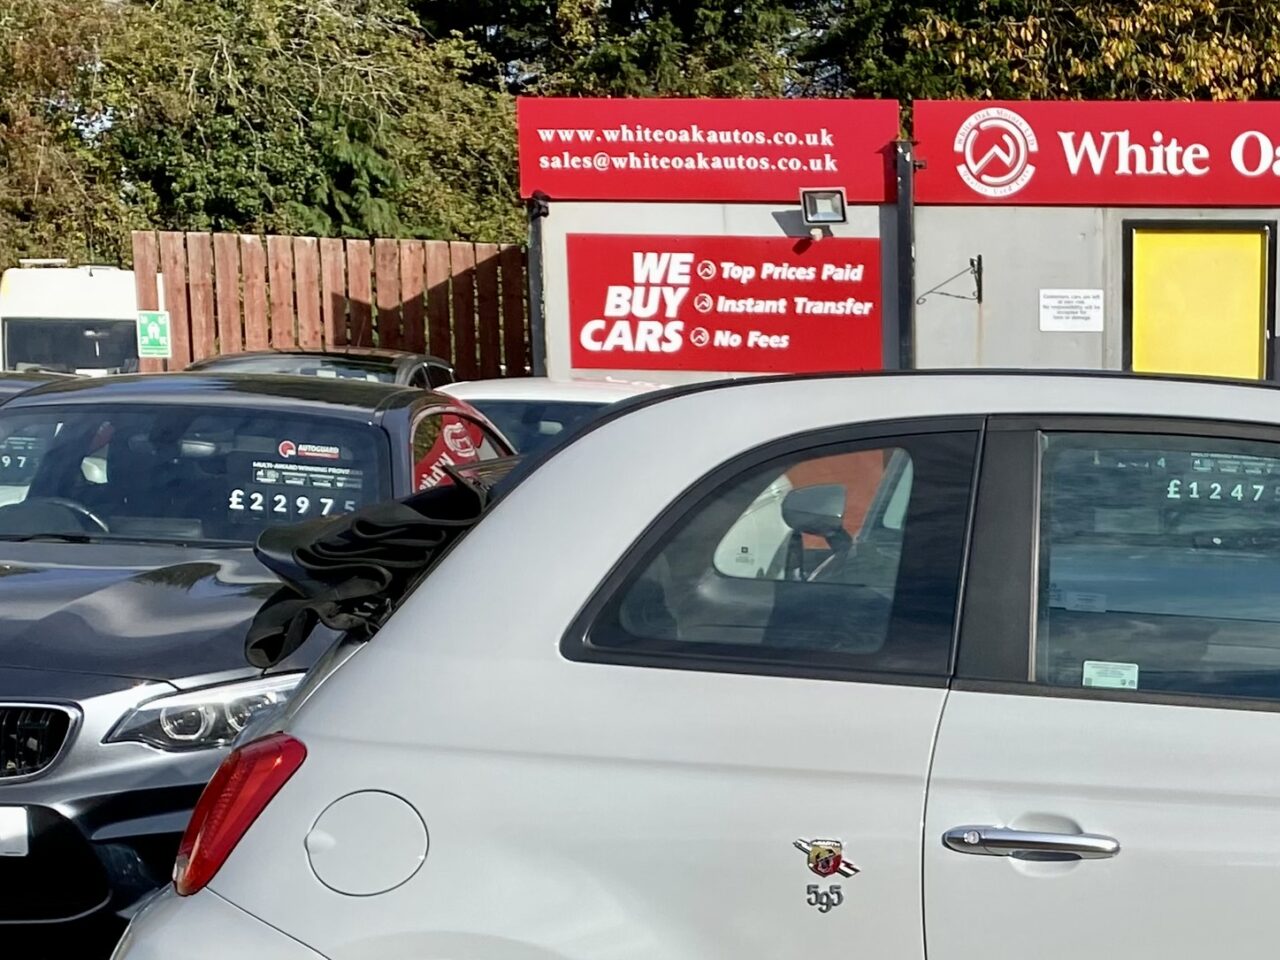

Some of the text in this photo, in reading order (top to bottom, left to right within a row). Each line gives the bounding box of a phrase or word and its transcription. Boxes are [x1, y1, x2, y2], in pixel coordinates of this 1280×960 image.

[537, 125, 834, 147] www.whiteoakautos.co.uk
[539, 152, 838, 172] sales@whiteoakautos.co.uk
[1057, 130, 1210, 177] White
[633, 253, 694, 285] WE
[721, 262, 864, 284] Top Prices Paid
[604, 286, 689, 319] BUY
[716, 295, 873, 316] Instant Transfer
[580, 319, 684, 353] CARS
[714, 331, 790, 348] No Fees
[298, 444, 339, 454] AUTOGUARD
[229, 489, 356, 516] £22975
[806, 884, 844, 913] 595
